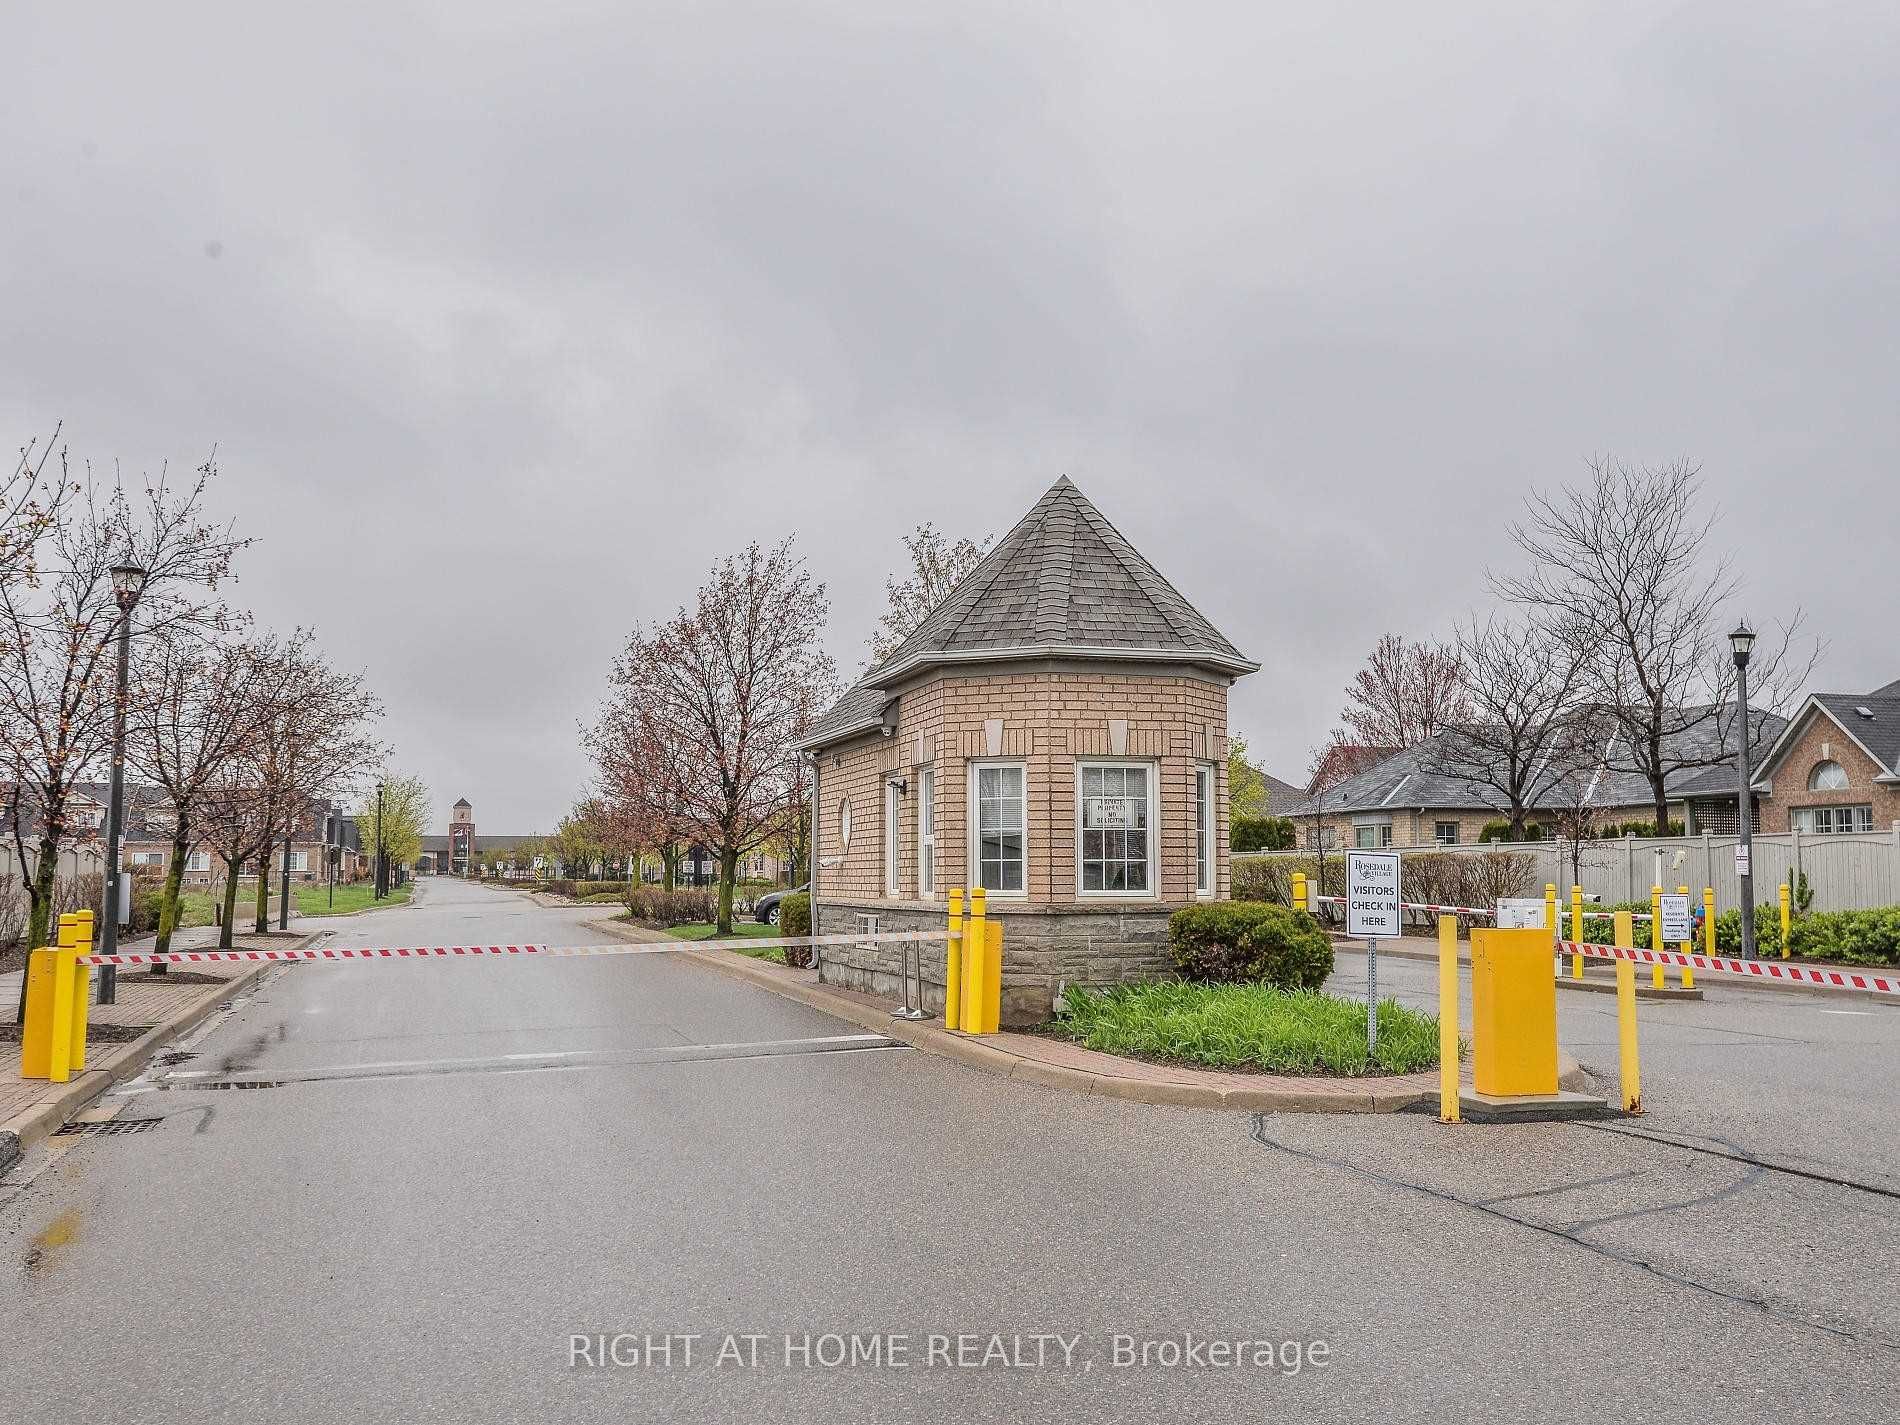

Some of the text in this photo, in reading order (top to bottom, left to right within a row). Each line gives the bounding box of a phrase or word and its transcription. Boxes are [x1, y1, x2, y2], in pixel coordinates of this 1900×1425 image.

[1355, 860, 1393, 872] ROSEDALE
[1353, 886, 1395, 896] VISITORS
[1351, 901, 1397, 911] CHECK IN
[1361, 917, 1387, 926] HERE
